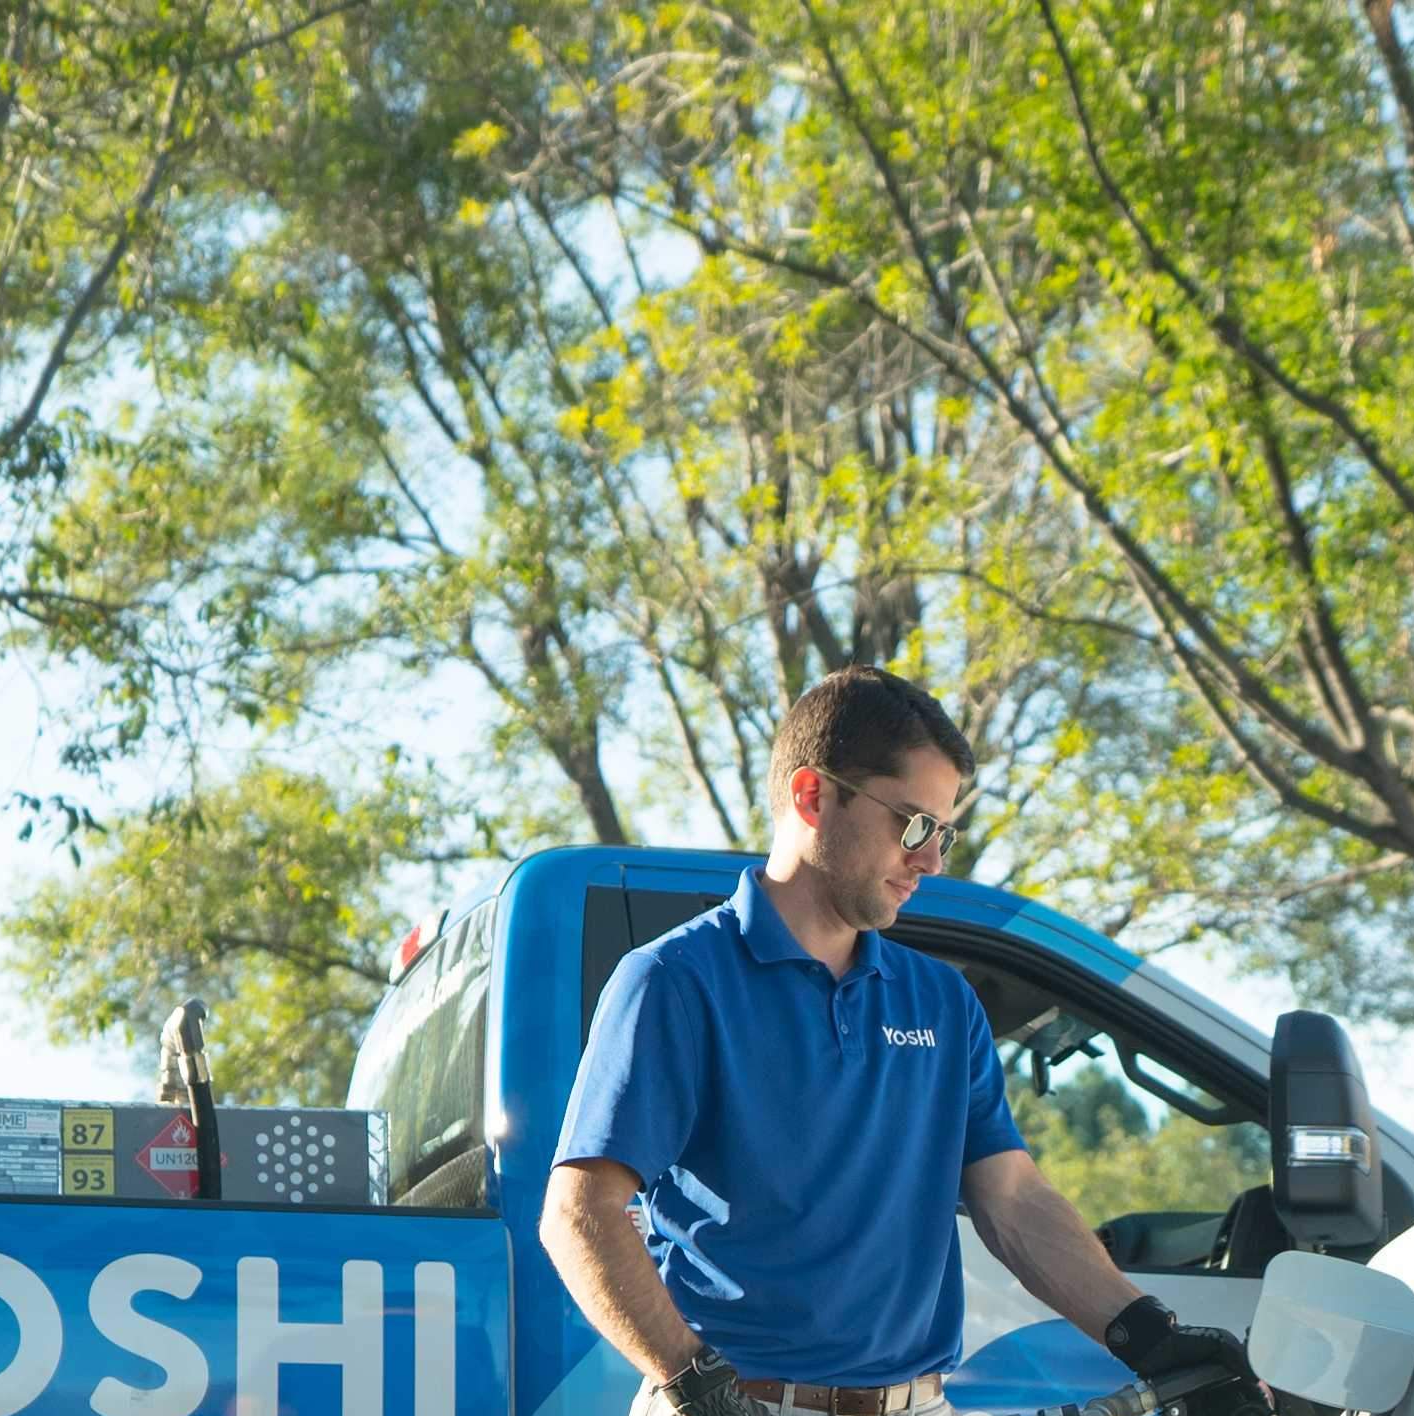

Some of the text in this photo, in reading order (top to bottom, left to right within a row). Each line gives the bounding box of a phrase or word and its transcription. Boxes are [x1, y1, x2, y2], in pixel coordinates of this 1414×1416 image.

[882, 1025, 936, 1047] YOSHI
[72, 1123, 106, 1145] 87
[72, 1168, 106, 1191] 93
